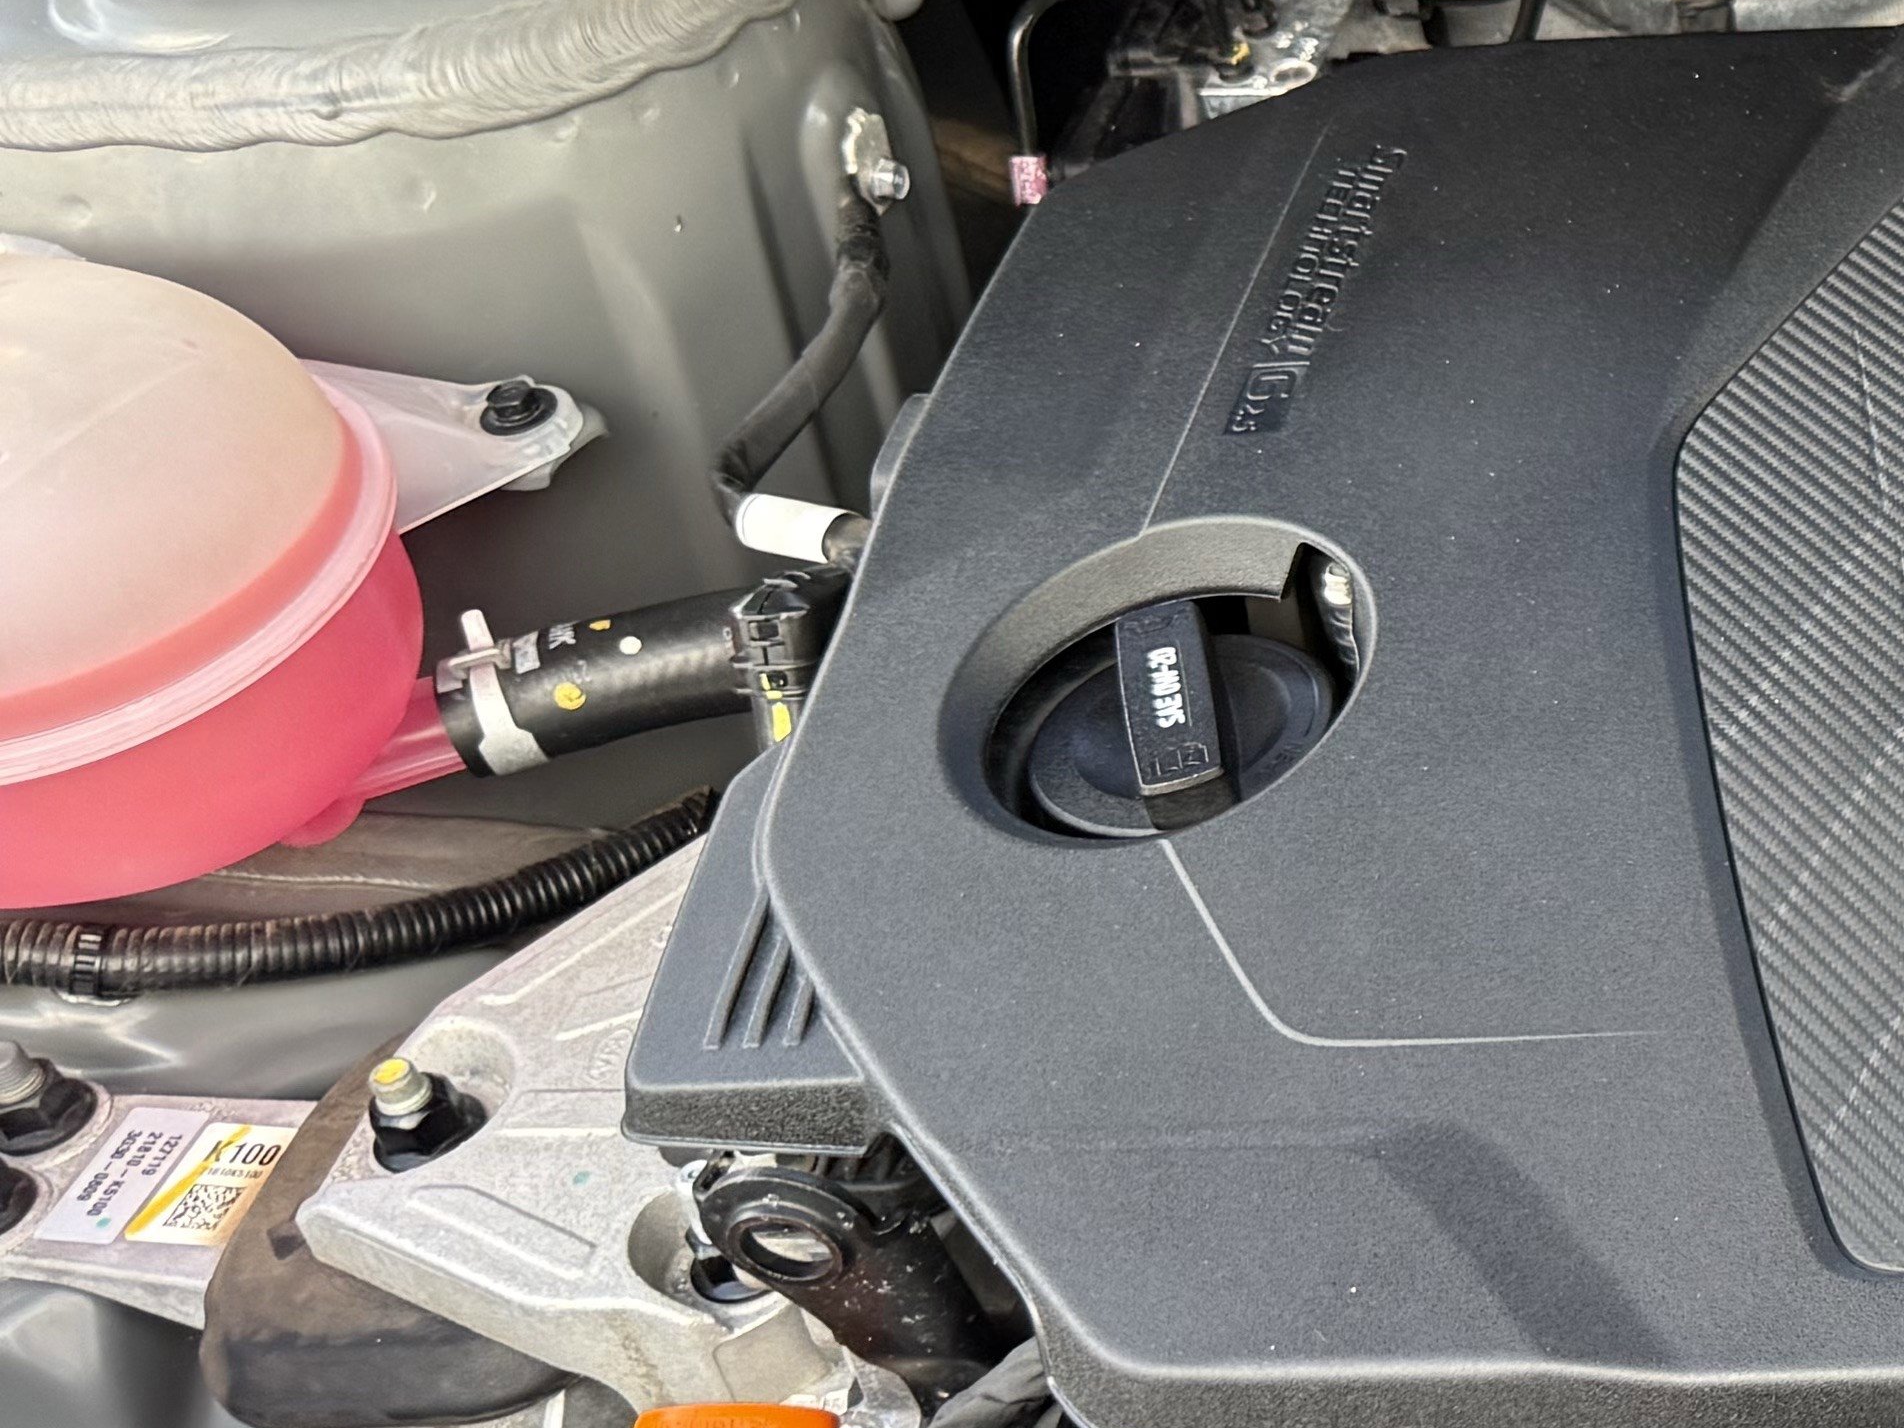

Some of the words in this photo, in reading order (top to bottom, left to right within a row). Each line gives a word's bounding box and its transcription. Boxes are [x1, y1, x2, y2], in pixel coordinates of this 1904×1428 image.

[1255, 164, 1357, 354] TECHNOLOGY
[1146, 646, 1181, 696] 0W-20
[1150, 696, 1187, 729] SAE
[139, 1133, 185, 1176] 127119
